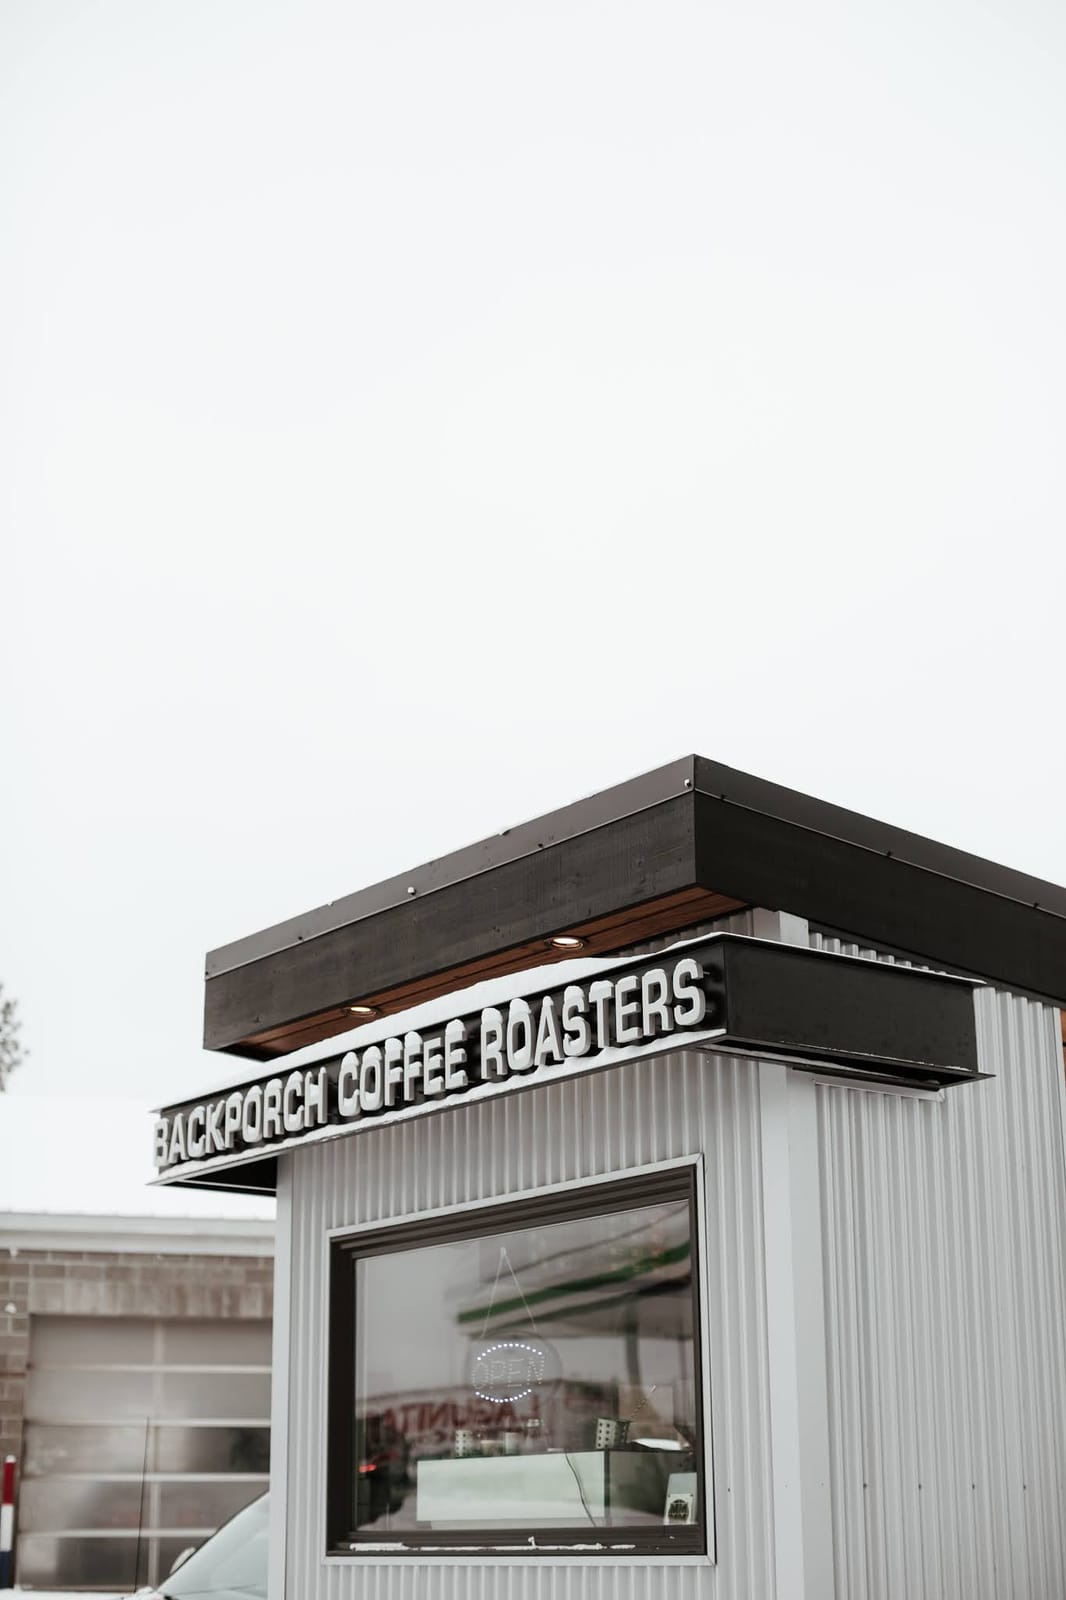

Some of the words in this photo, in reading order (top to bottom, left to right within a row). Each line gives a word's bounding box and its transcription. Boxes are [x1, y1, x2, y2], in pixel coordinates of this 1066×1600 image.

[154, 1067, 328, 1167] BACKPORCH
[338, 1019, 468, 1117] COFFEE
[480, 958, 706, 1079] ROASTERS
[472, 1356, 544, 1389] OPEN
